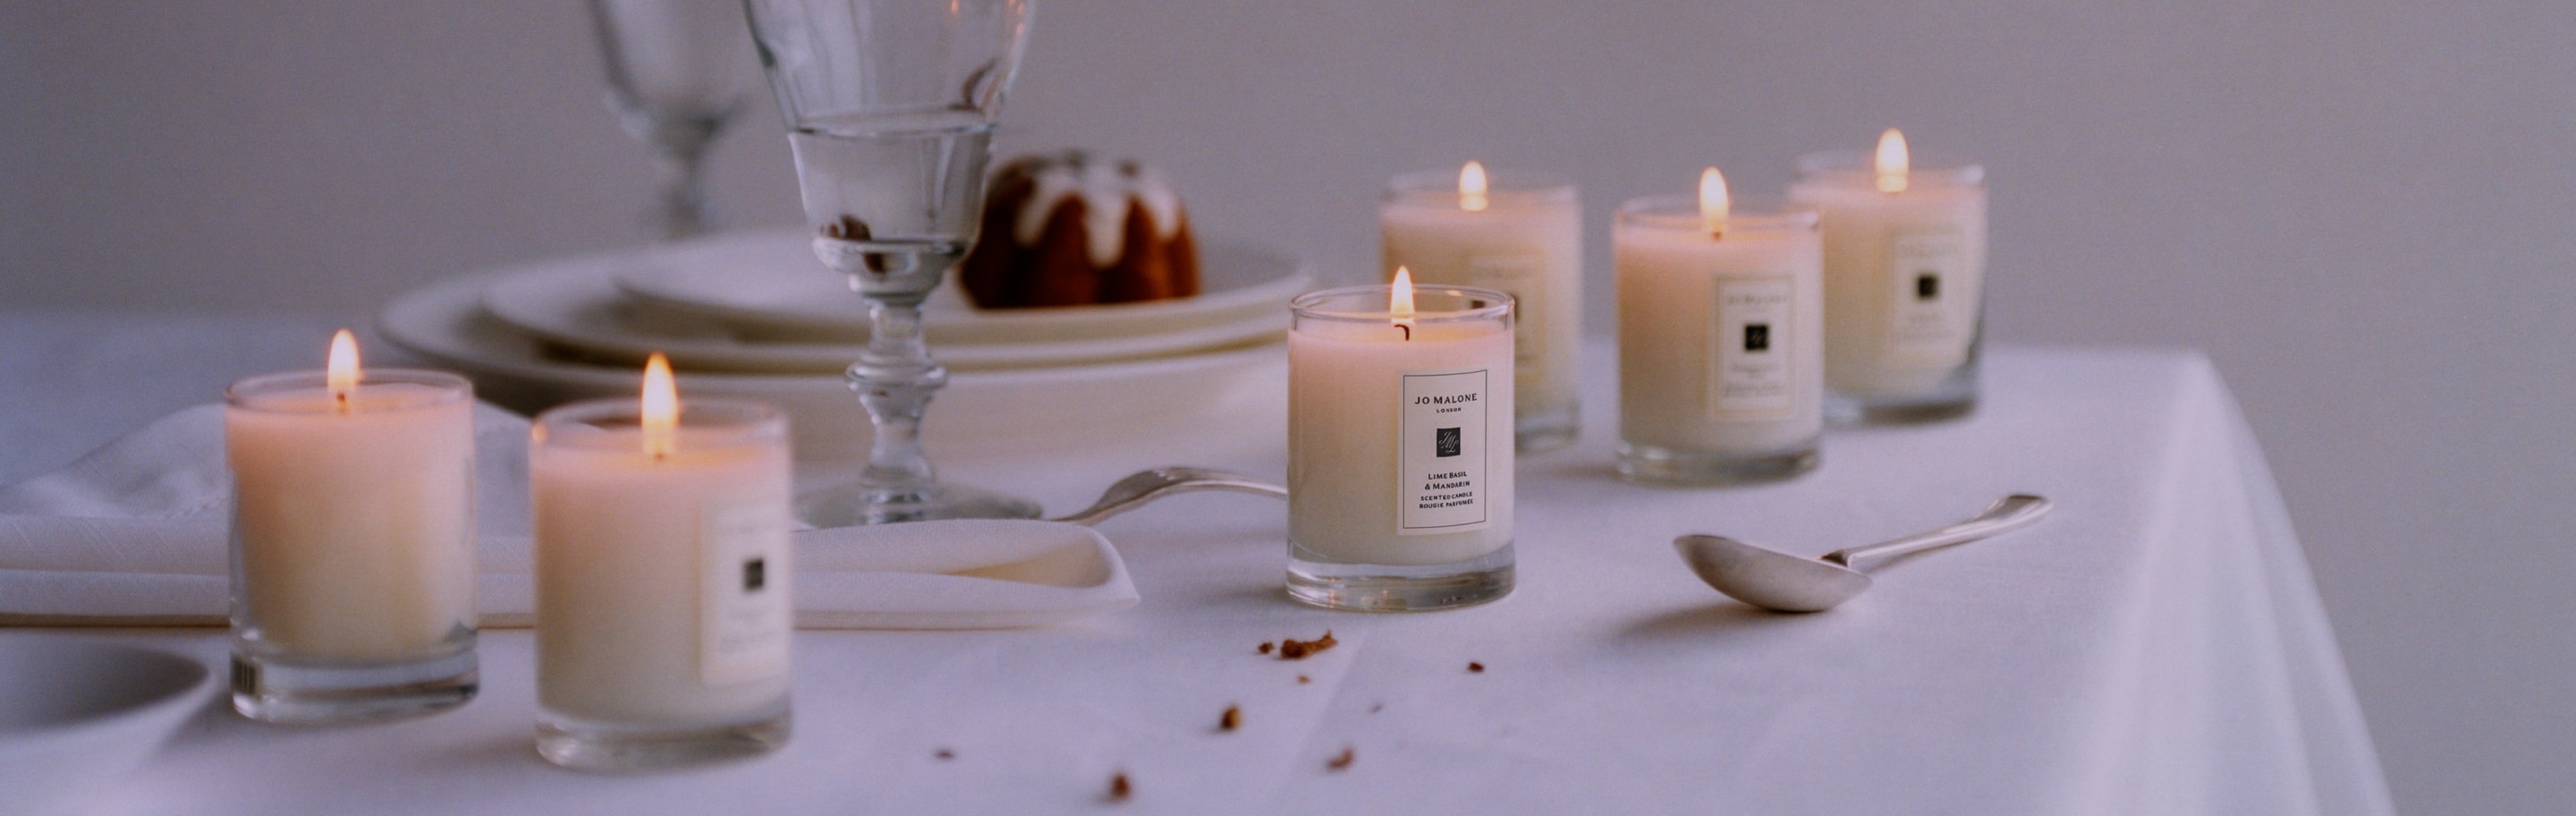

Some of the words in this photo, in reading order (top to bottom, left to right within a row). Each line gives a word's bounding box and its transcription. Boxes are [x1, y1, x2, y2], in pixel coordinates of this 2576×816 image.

[1414, 396, 1430, 404] JO
[1434, 394, 1478, 404] MALONE
[1449, 471, 1467, 479] BASIL
[1432, 480, 1470, 489] MANDARIN
[1452, 491, 1473, 499] CANDLE
